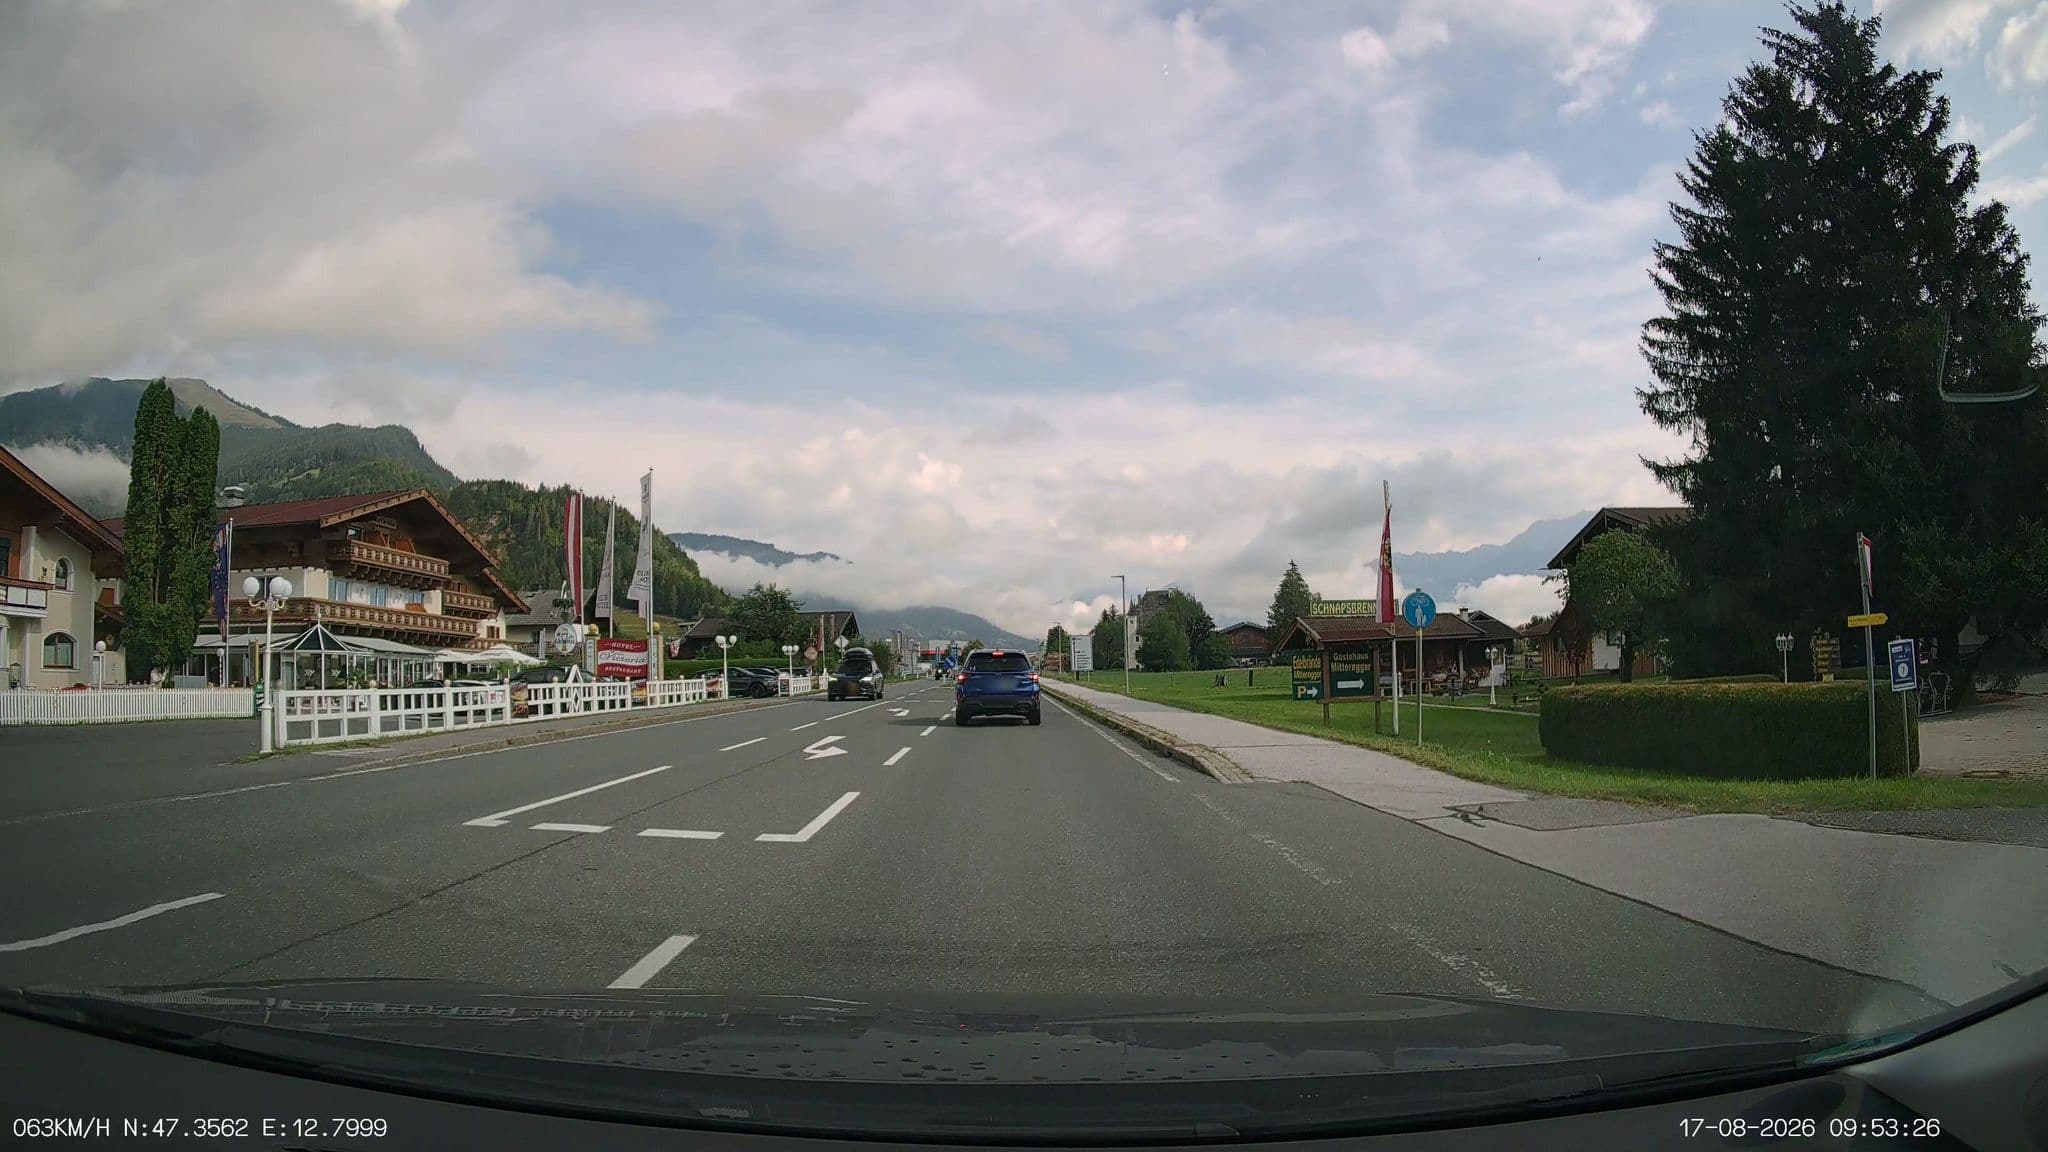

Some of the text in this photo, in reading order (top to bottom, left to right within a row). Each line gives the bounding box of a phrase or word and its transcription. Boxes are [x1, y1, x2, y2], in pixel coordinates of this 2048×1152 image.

[611, 642, 634, 650] HOTEL
[599, 651, 645, 663] Victoria
[604, 666, 642, 674] RESTAURANT
[1297, 686, 1307, 698] P
